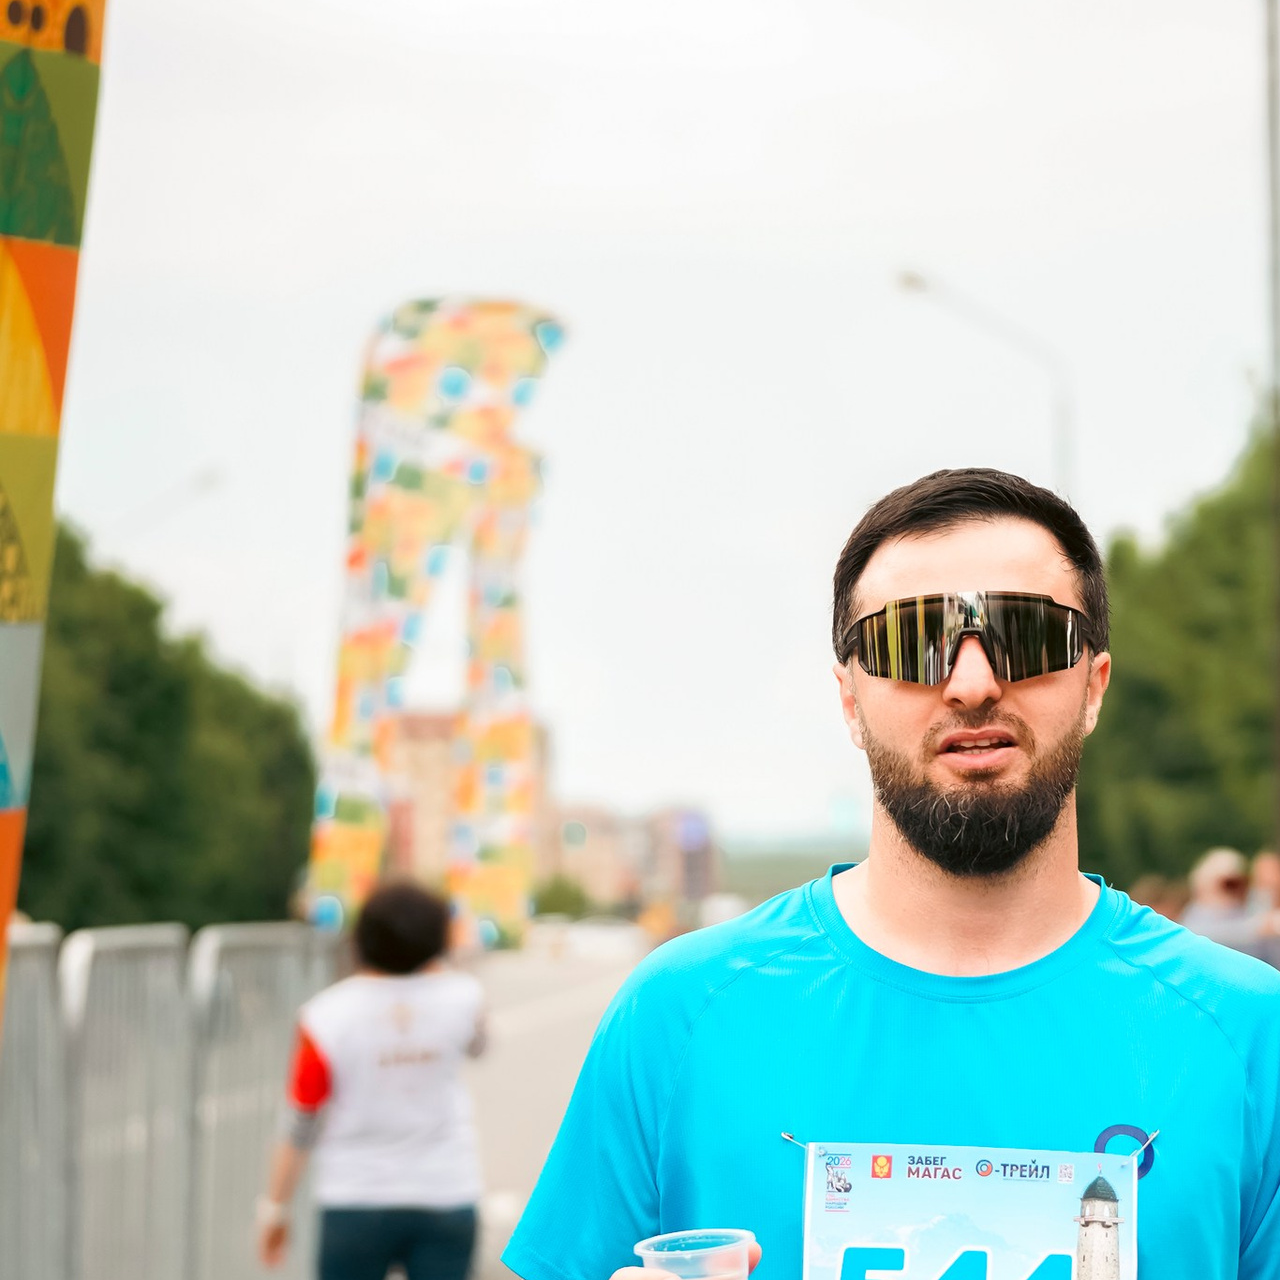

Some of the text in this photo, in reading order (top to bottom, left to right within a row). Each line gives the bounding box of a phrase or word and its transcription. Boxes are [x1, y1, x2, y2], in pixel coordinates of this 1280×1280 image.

[827, 1156, 852, 1166] 2026
[907, 1155, 947, 1166] ЗАБЕГ
[907, 1166, 963, 1180] МАГАС
